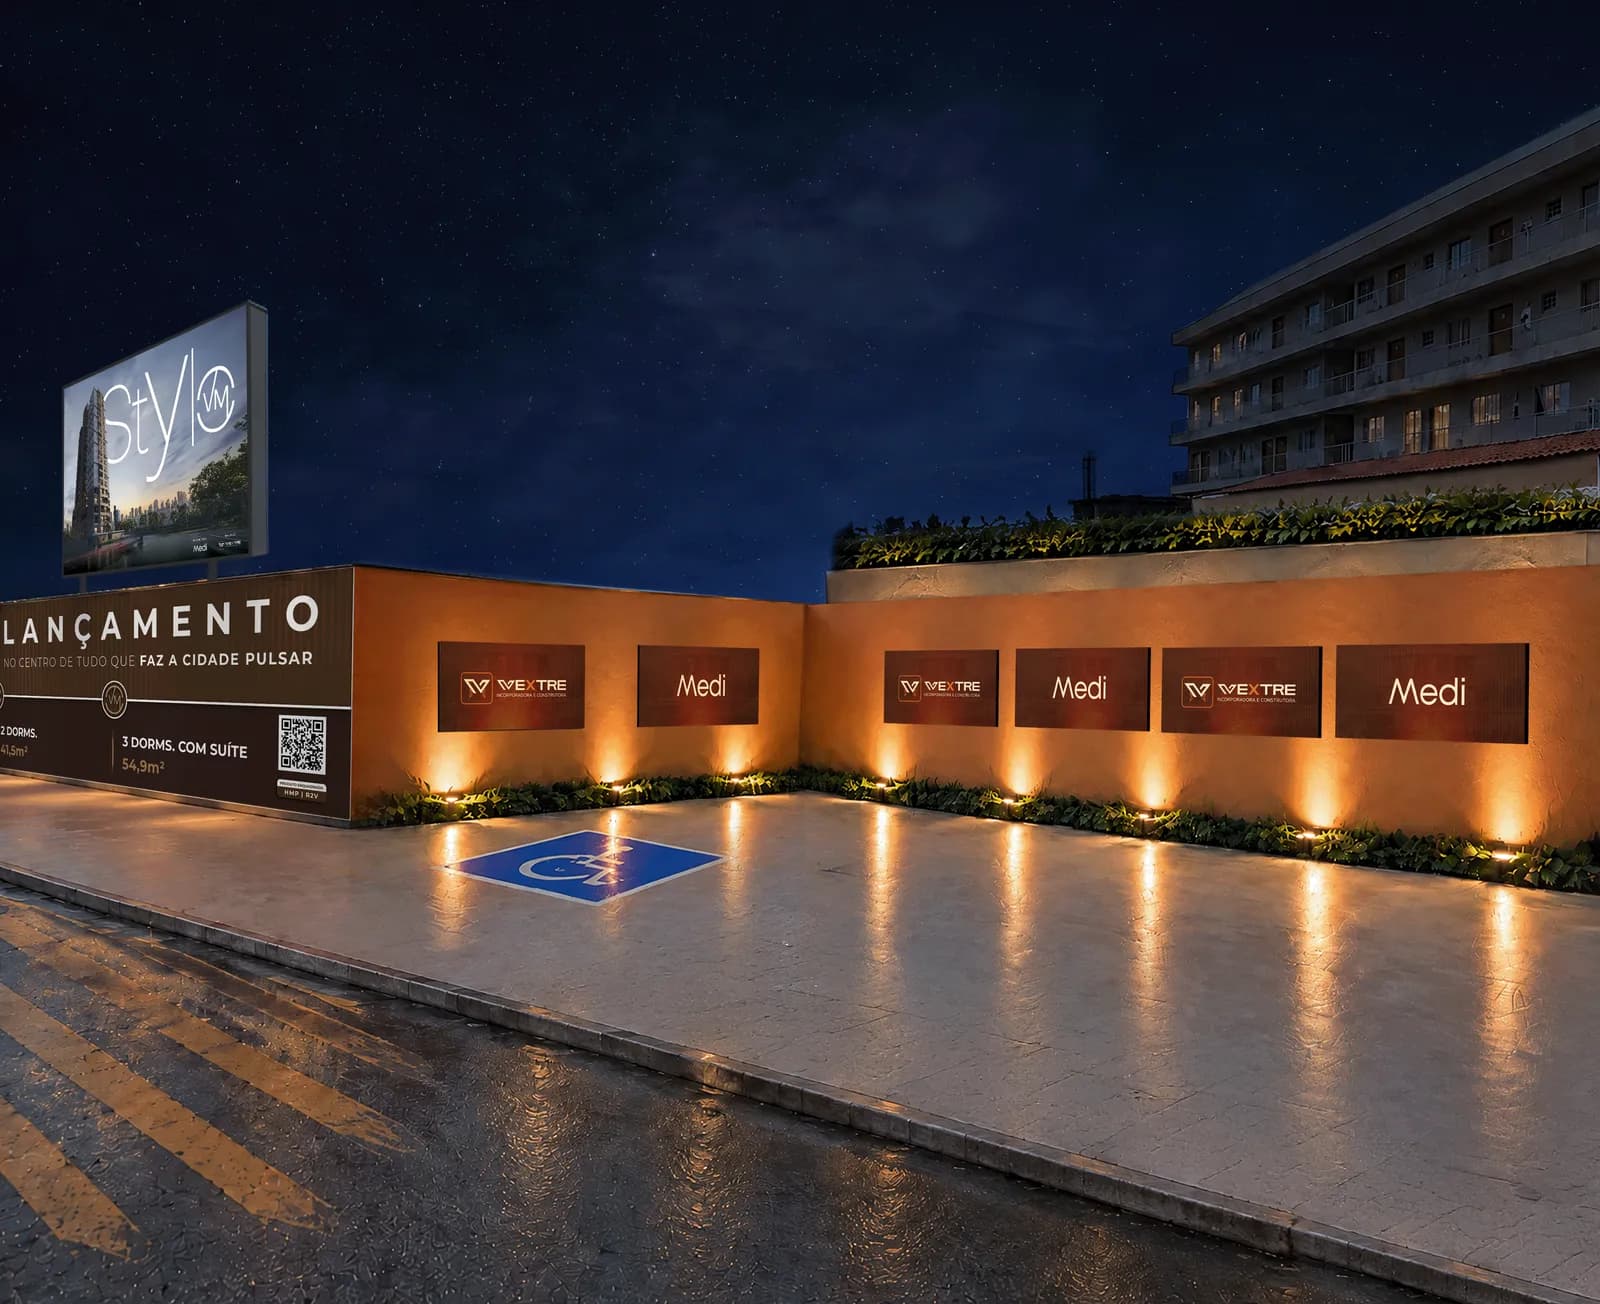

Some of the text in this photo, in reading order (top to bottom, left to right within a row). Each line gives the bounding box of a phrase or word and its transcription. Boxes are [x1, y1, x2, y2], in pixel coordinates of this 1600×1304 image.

[3, 594, 319, 649] LANÇAMENTO
[3, 651, 313, 668] NO CENTRO DE TUDO QUE FAZ A CIDADE PULSAR
[676, 674, 726, 698] Medi
[1052, 675, 1107, 700] Medi
[1388, 677, 1466, 706] Medi
[6, 726, 38, 739] DORMS.
[122, 736, 248, 760] 3 DORMS. COM SUÍTE
